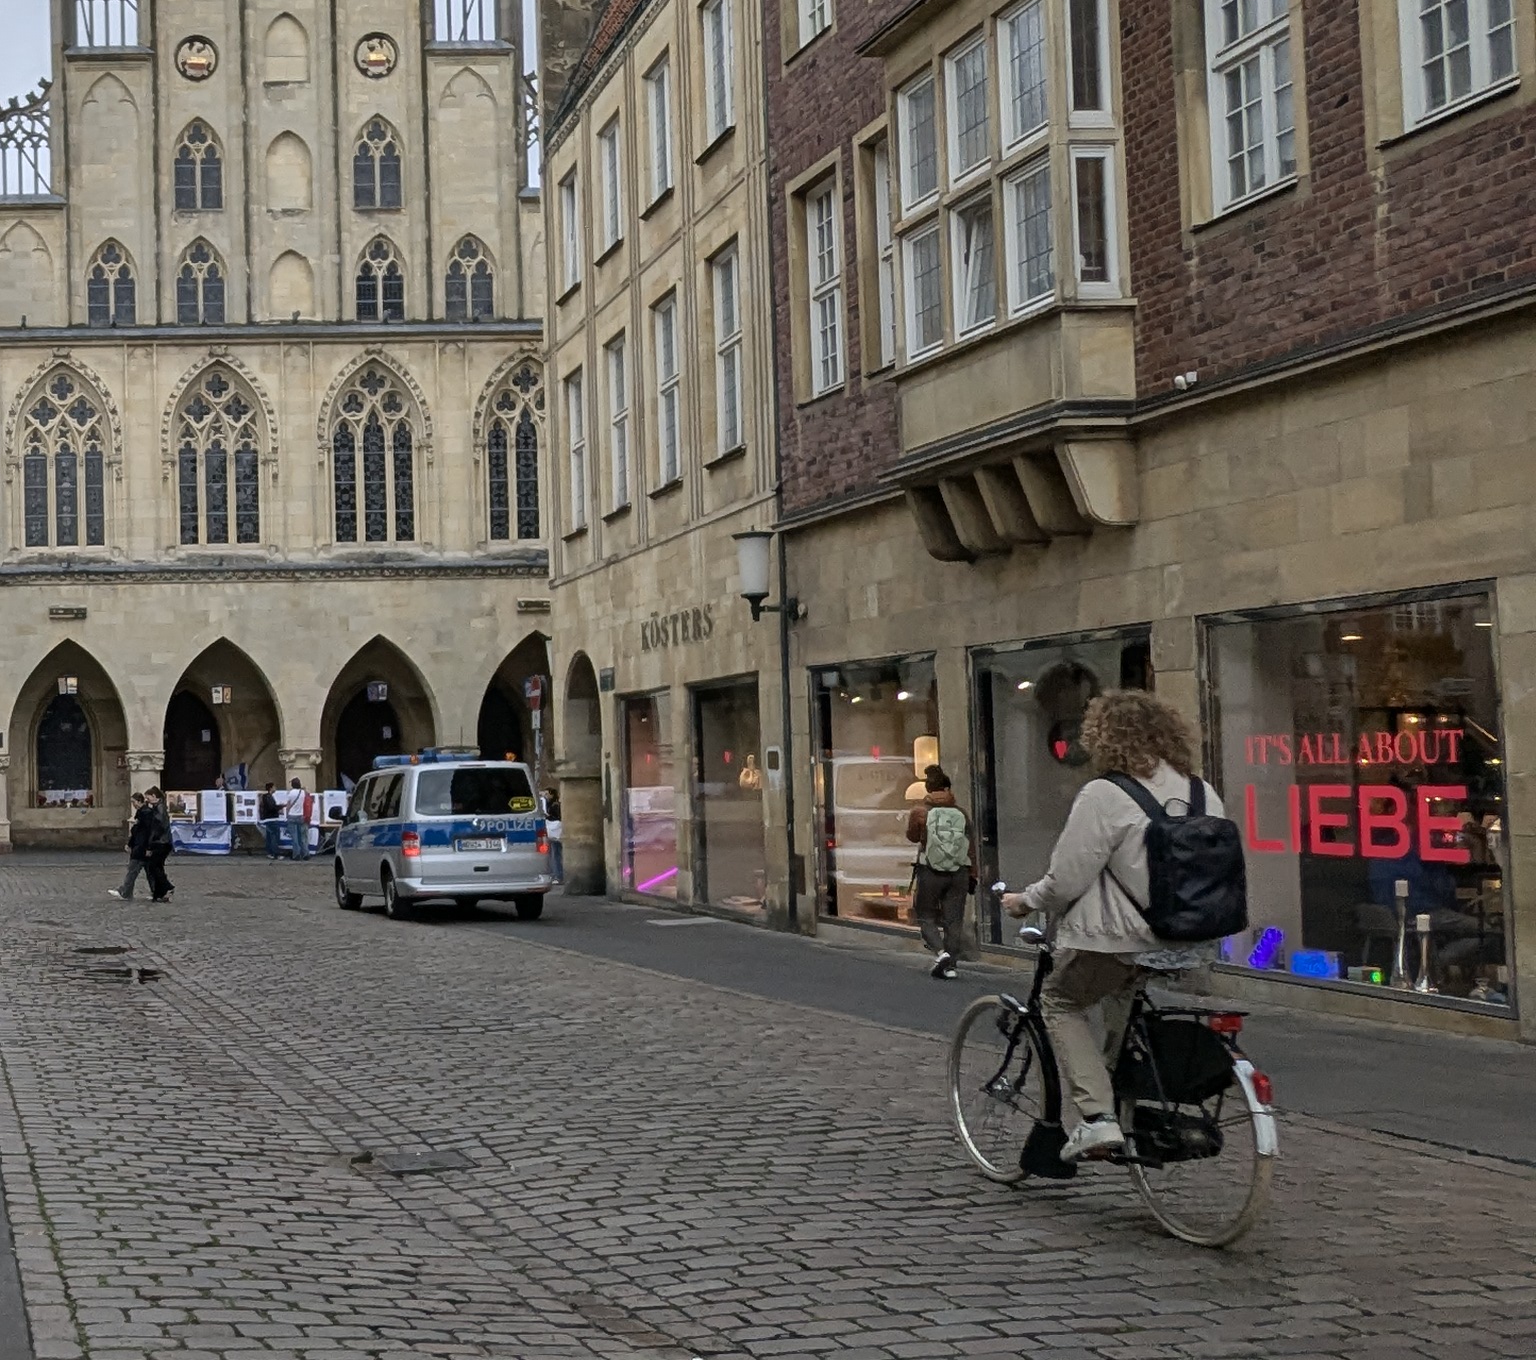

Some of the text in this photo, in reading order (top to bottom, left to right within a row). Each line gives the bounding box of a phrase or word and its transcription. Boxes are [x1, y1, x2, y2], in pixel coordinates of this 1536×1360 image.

[641, 604, 713, 651] KÖSTERS
[1245, 730, 1463, 765] IT'S ALL ABOUT
[487, 820, 536, 832] POLIZEI
[1245, 784, 1471, 863] LIEBE
